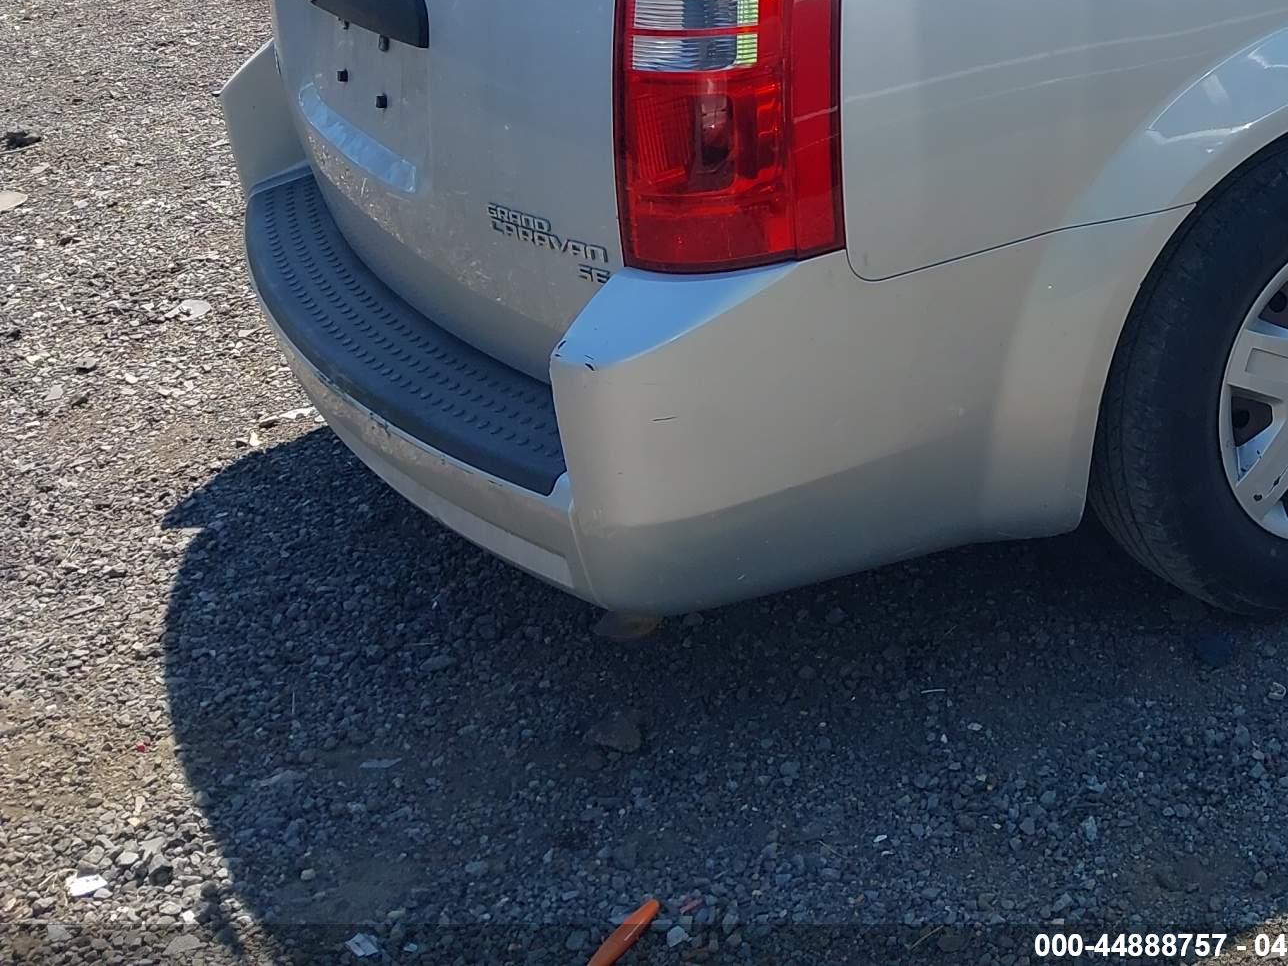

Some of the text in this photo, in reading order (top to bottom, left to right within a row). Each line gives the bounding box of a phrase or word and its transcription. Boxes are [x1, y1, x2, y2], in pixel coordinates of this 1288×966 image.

[487, 202, 551, 233] GRAND
[491, 220, 608, 263] CARAVAN
[577, 263, 611, 285] SE
